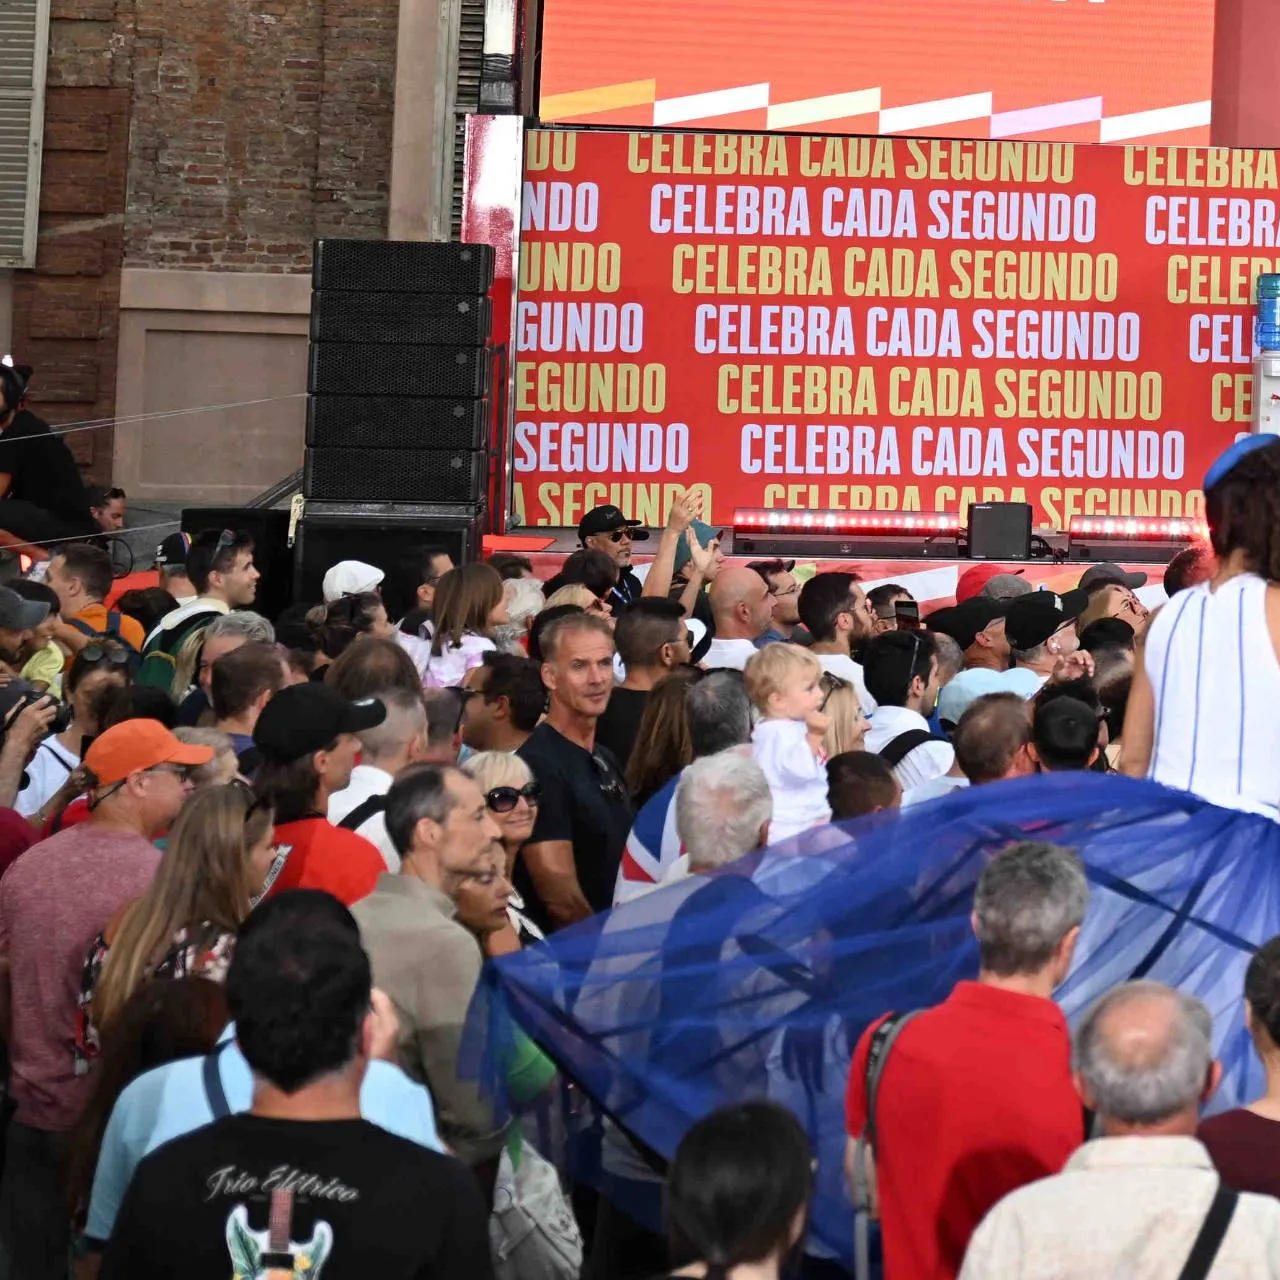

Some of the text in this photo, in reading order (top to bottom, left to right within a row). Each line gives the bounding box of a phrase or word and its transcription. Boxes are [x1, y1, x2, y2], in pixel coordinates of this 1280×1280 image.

[627, 132, 789, 177] CELEBRA
[799, 136, 896, 180] CADA
[905, 139, 1075, 185] SEGUNDO
[1123, 147, 1279, 190] CELEBRA
[649, 183, 811, 237] CELEBRA
[821, 186, 918, 239] CADA
[927, 189, 1097, 244] SEGUNDO
[672, 243, 833, 296] CELEBRA
[843, 246, 940, 299] CADA
[949, 248, 1119, 303] SEGUNDO
[694, 303, 856, 356] CELEBRA
[866, 306, 963, 358] CADA
[971, 308, 1140, 362] SEGUNDO
[717, 363, 878, 416] CELEBRA
[888, 366, 985, 418] CADA
[993, 367, 1163, 421] SEGUNDO
[514, 421, 1185, 481] SEGUNDO CELEBRA CADA SEGUNDO
